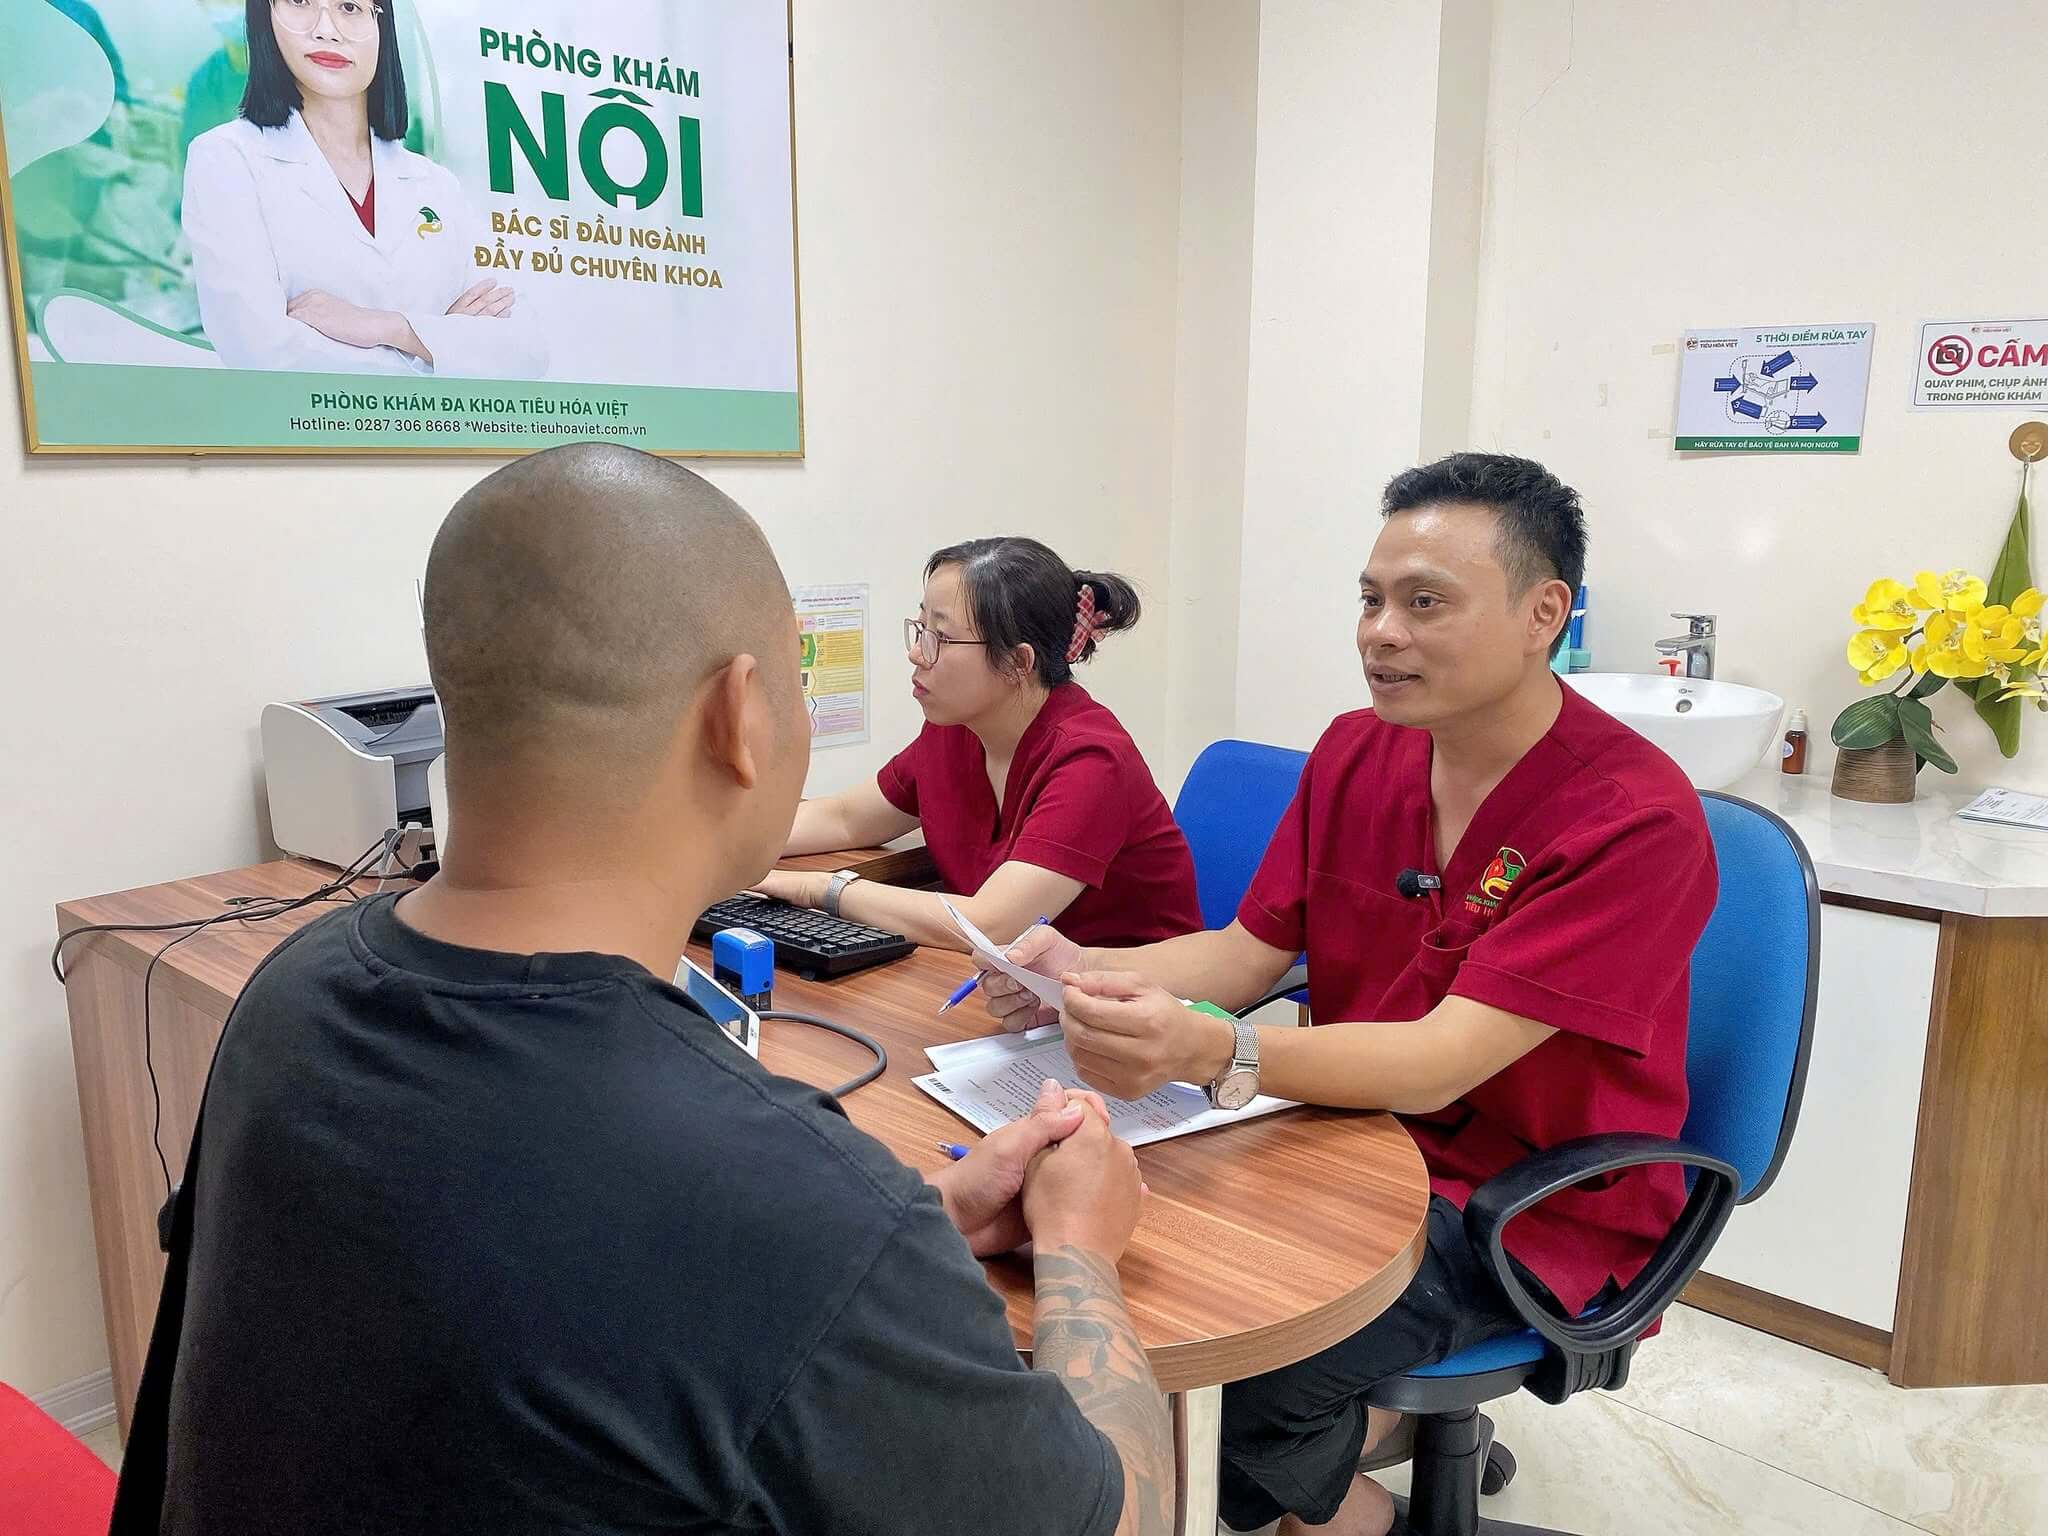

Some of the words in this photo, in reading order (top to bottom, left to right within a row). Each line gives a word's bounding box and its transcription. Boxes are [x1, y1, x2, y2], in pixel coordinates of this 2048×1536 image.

[480, 27, 601, 78] PHÒNG
[613, 55, 699, 98] KHÁM
[491, 208, 542, 237] BÁC
[550, 215, 569, 240] SĨ
[576, 213, 622, 246] ĐẦU
[630, 226, 705, 254] NGÀNH
[474, 237, 523, 270] ĐẦY
[531, 246, 562, 274] ĐỦ
[570, 256, 657, 282] CHUYÊN
[664, 265, 723, 289] KHOA
[1756, 334, 1762, 343] 5
[1764, 331, 1790, 343] THỜI
[1792, 328, 1819, 341] ĐIỂM
[1847, 329, 1867, 339] TAY
[1977, 337, 2048, 368] CẤM
[1764, 365, 1771, 374] 2
[1791, 379, 1797, 387] 4
[1924, 379, 1954, 389] QUAY
[1955, 378, 1986, 389] PHIM,
[1988, 378, 2021, 390] CHỤP
[1926, 392, 1964, 401] TRONG
[2007, 390, 2042, 401] KHÁM
[311, 390, 378, 410] PHÒNG
[383, 393, 436, 411] KHÁM
[440, 397, 465, 412] ĐA
[470, 398, 516, 414] KHOA
[519, 397, 555, 414] TIÊU
[560, 398, 593, 415] HÓA
[595, 400, 629, 419] VIỆT
[1734, 401, 1741, 409] 3
[290, 417, 350, 431] Hotline:
[354, 418, 390, 431] 0287
[394, 419, 422, 432] 306
[425, 420, 461, 432] 8668
[531, 421, 647, 436] tieuhoaviet.com.vn
[1792, 418, 1798, 426] 5
